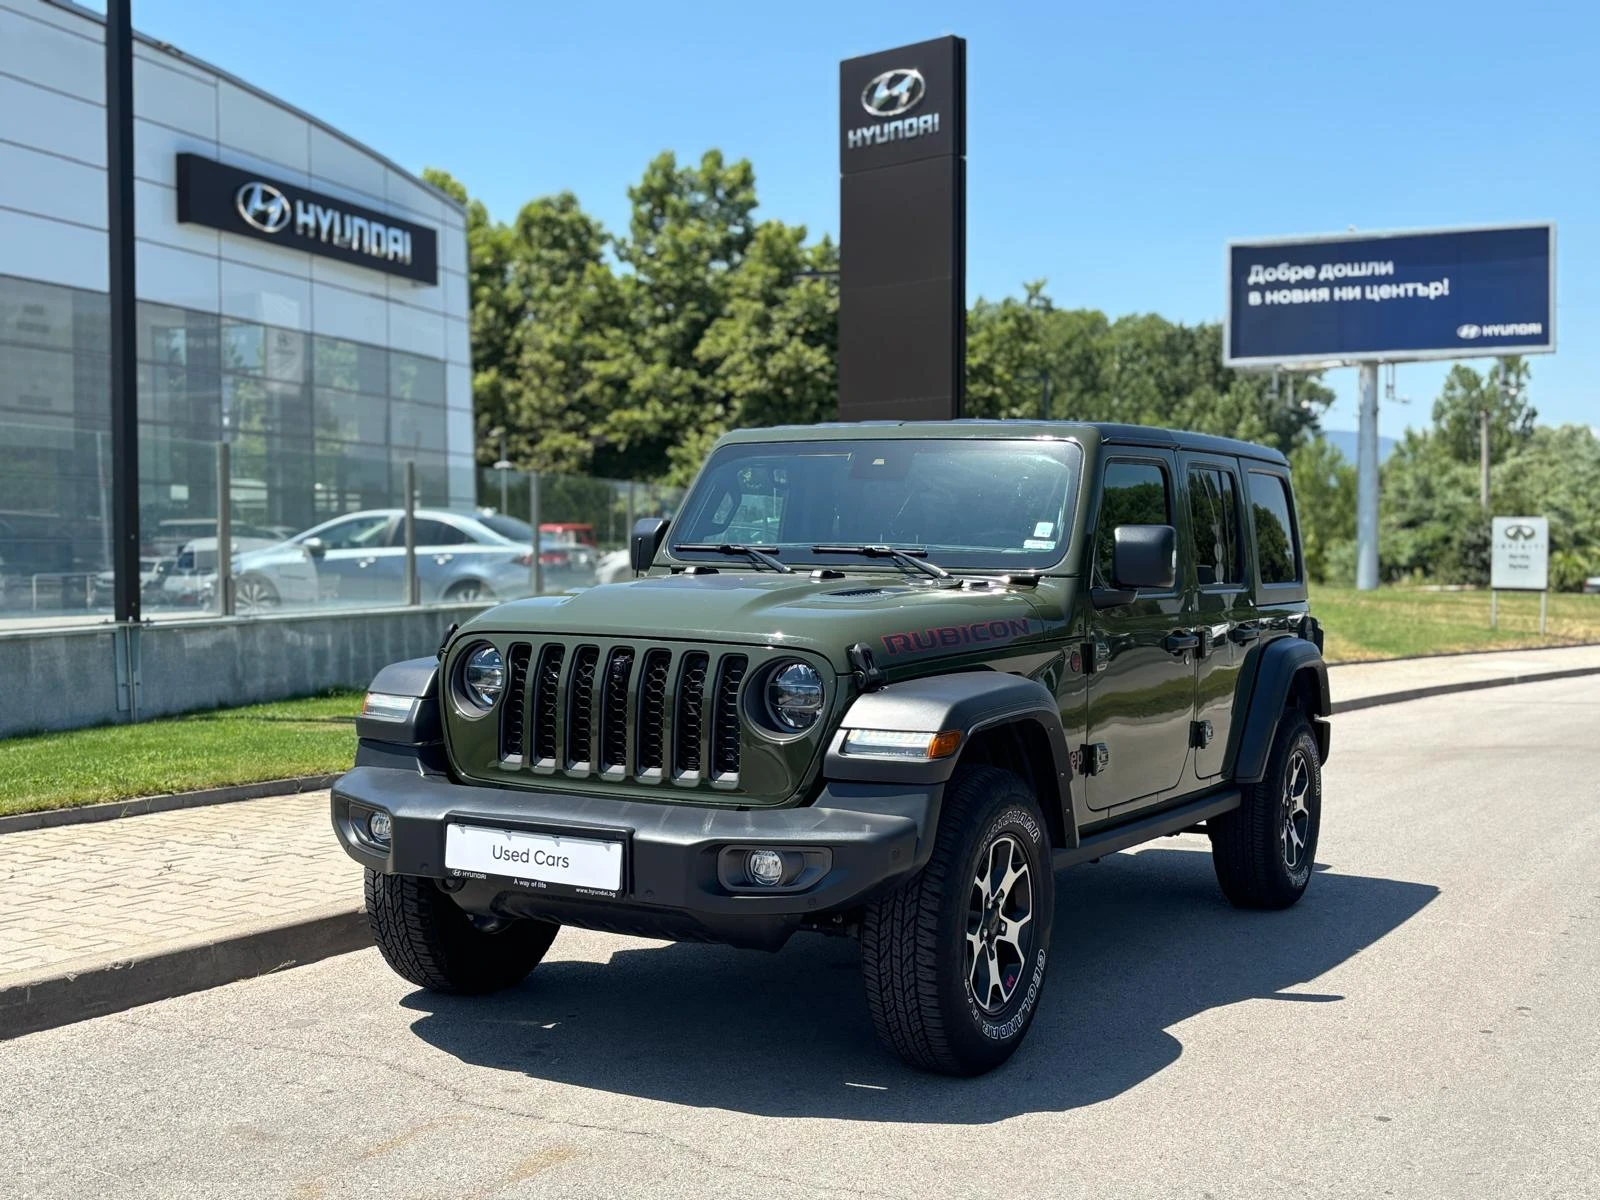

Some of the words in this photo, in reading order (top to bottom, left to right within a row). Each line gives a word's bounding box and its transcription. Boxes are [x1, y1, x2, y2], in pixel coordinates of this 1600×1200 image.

[848, 113, 940, 149] HYUNDAI
[296, 200, 412, 265] HYUNDAI
[1248, 263, 1316, 285] Добре
[1318, 261, 1394, 281] дошли
[1248, 291, 1262, 306] в
[1265, 287, 1330, 305] новия
[1333, 286, 1361, 301] ни
[1365, 278, 1449, 302] център!
[1482, 323, 1542, 336] HYUNDAI
[881, 618, 1030, 656] RUBICON
[492, 845, 529, 863] Used
[534, 849, 569, 868] Cars
[462, 871, 487, 880] HYUNDAI
[519, 880, 530, 888] way
[576, 887, 616, 898] www.hyundai.bg
